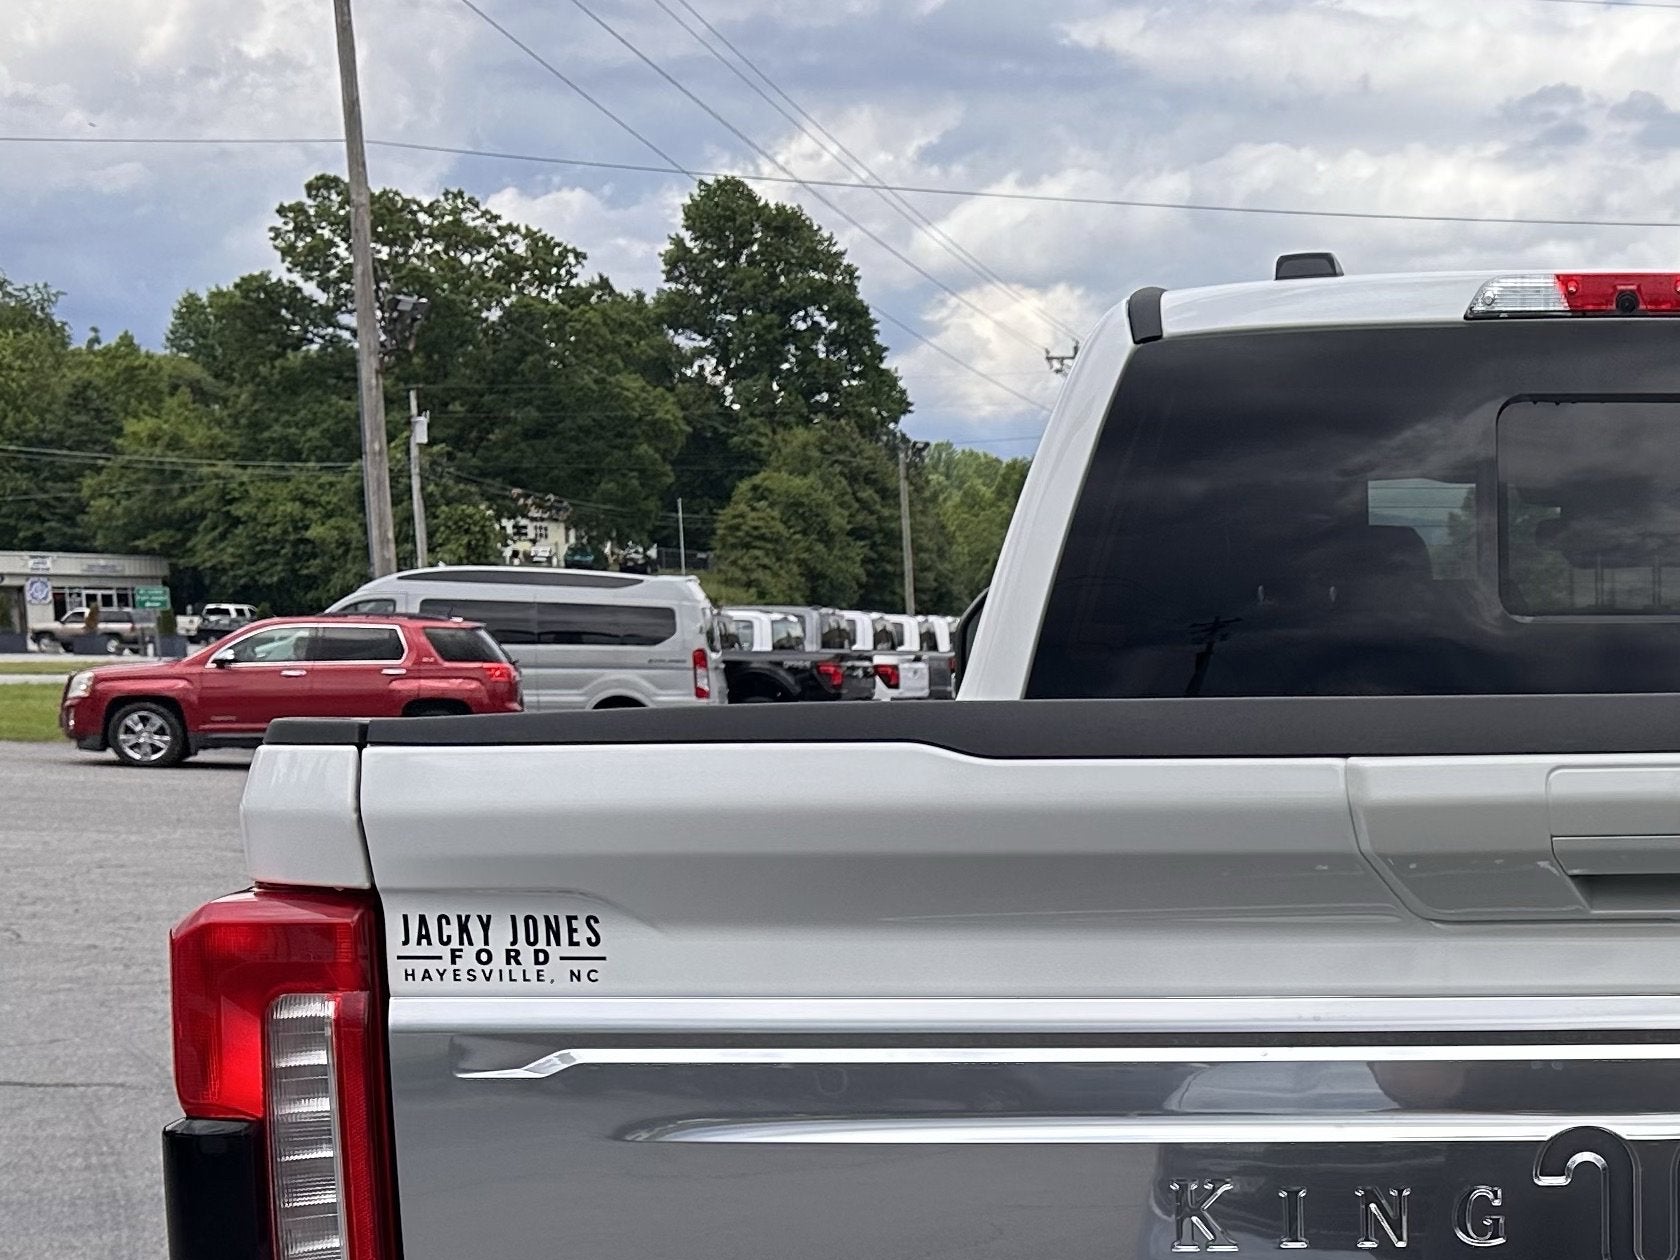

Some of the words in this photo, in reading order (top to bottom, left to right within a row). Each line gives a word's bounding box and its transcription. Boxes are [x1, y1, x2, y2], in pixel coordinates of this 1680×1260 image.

[401, 913, 492, 947] JACKY
[509, 914, 601, 947] JONES
[450, 948, 551, 966] FORD
[404, 968, 555, 984] HAYESVILLE,
[569, 969, 600, 983] NC
[1169, 1177, 1507, 1253] KING
